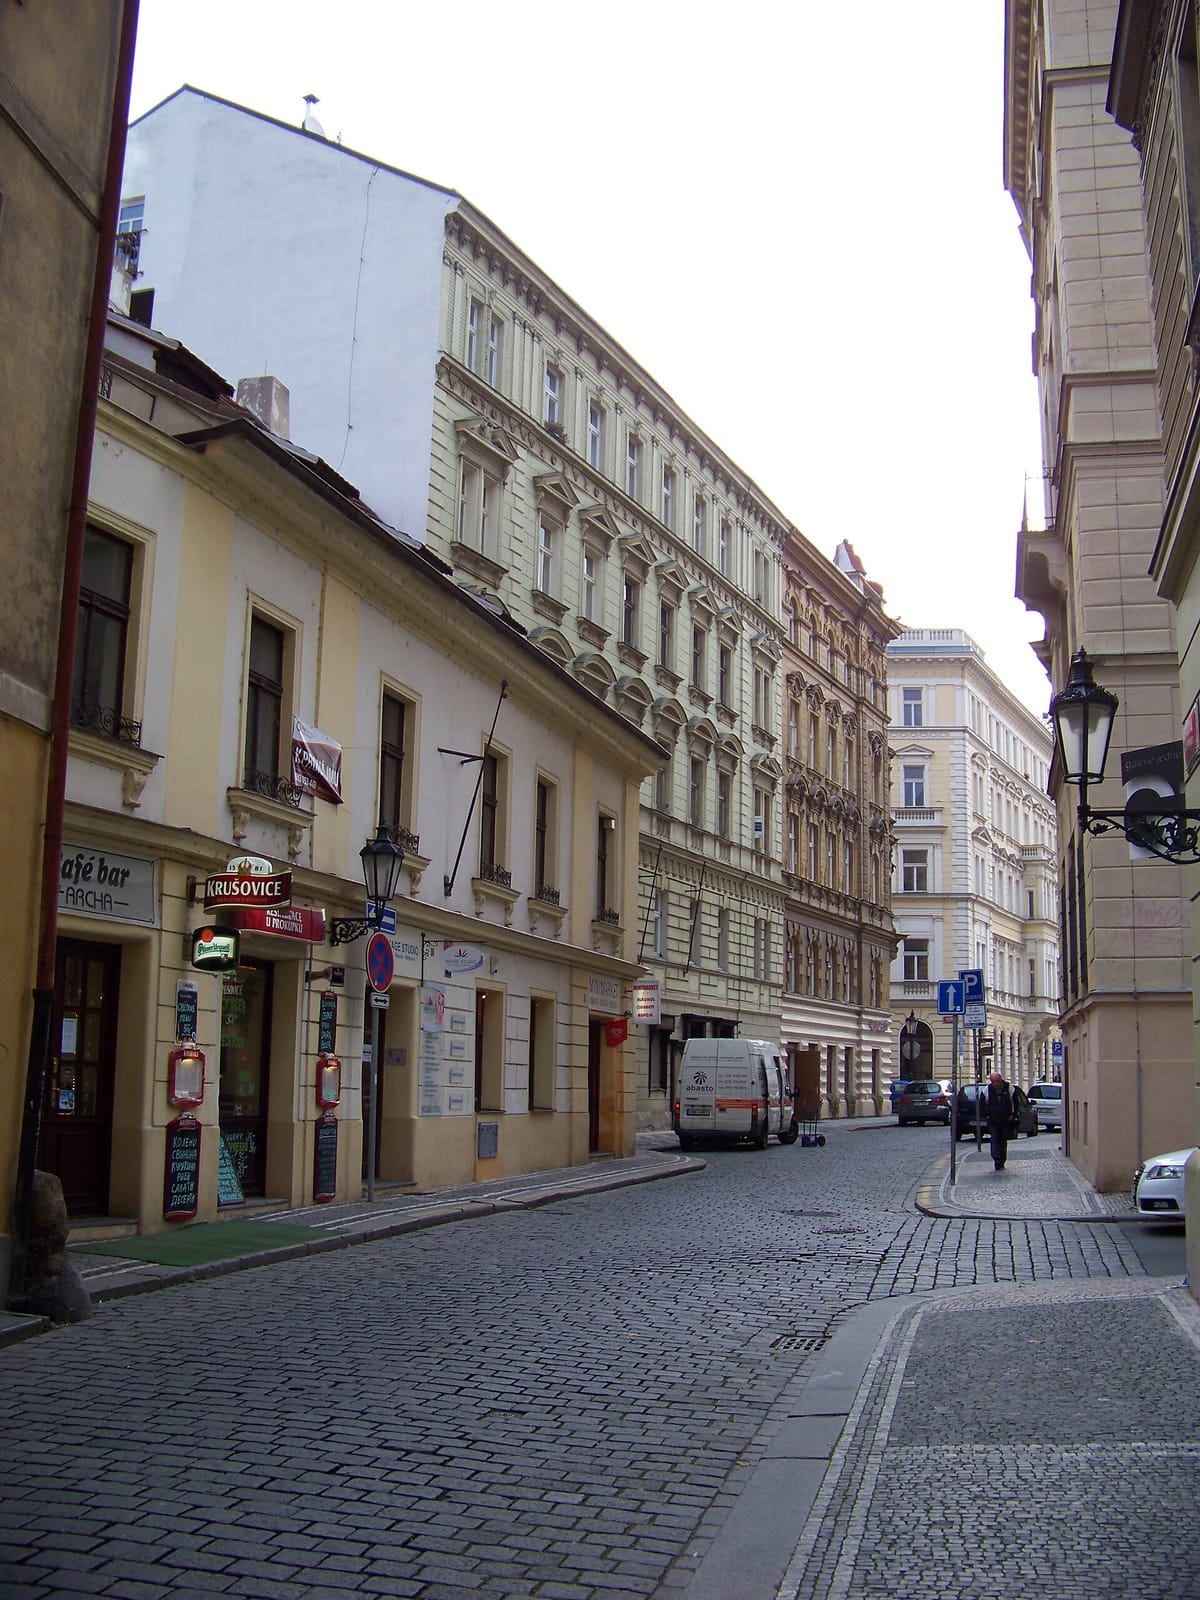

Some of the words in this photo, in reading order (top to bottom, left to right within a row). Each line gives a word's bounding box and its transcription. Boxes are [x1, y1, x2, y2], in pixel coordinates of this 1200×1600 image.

[61, 853, 95, 885] afé
[98, 857, 130, 888] bar
[206, 879, 282, 897] KRUŠOVICE
[65, 886, 113, 911] ARCHA
[402, 943, 419, 956] STUDIO
[965, 974, 978, 993] P
[1055, 1043, 1061, 1052] P
[686, 1084, 714, 1093] abasto
